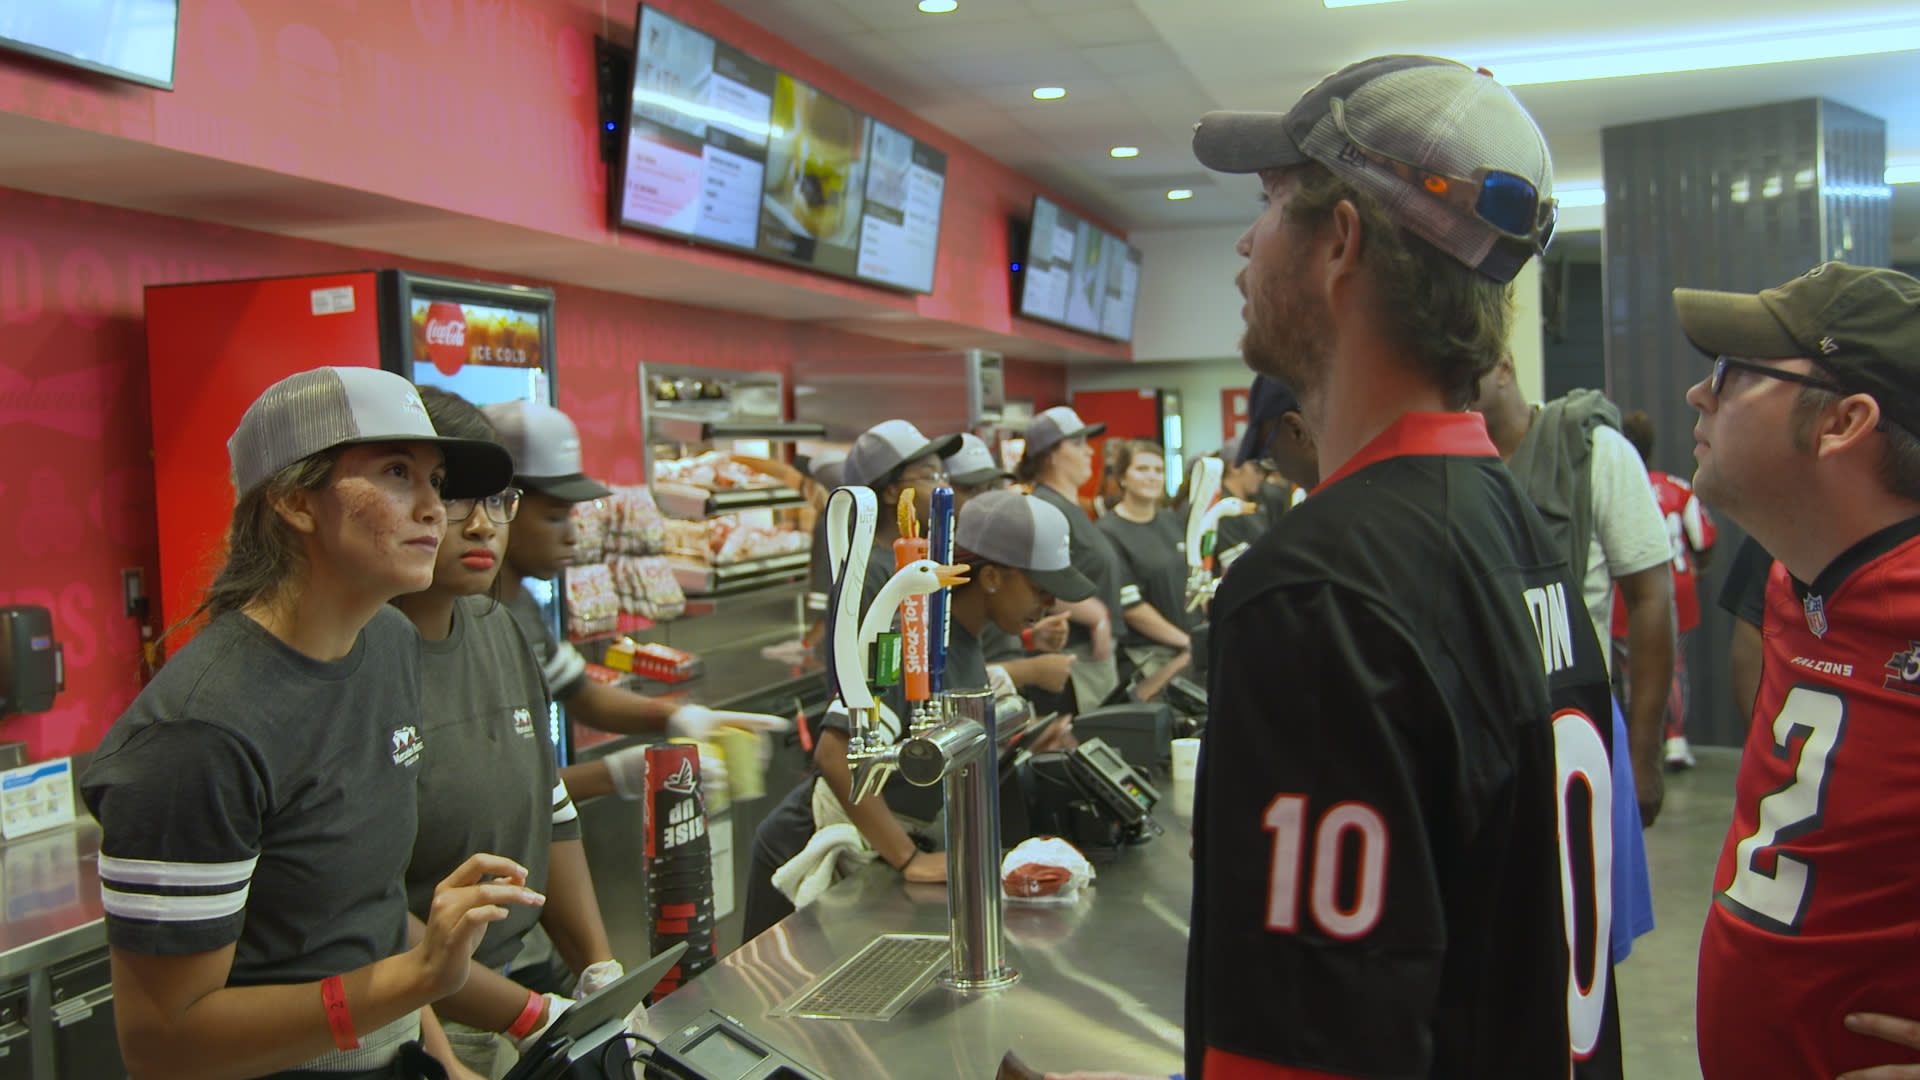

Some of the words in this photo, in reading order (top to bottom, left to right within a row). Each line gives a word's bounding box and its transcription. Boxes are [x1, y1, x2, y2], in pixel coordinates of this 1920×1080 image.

[472, 345, 491, 361] ICE
[496, 347, 526, 363] COLD
[904, 596, 920, 626] TOP
[904, 626, 922, 675] SHOCK
[1791, 656, 1853, 677] FALCONS
[669, 799, 695, 825] UP
[1715, 682, 1847, 935] 2
[664, 816, 704, 849] RISE
[1261, 792, 1390, 941] 10
